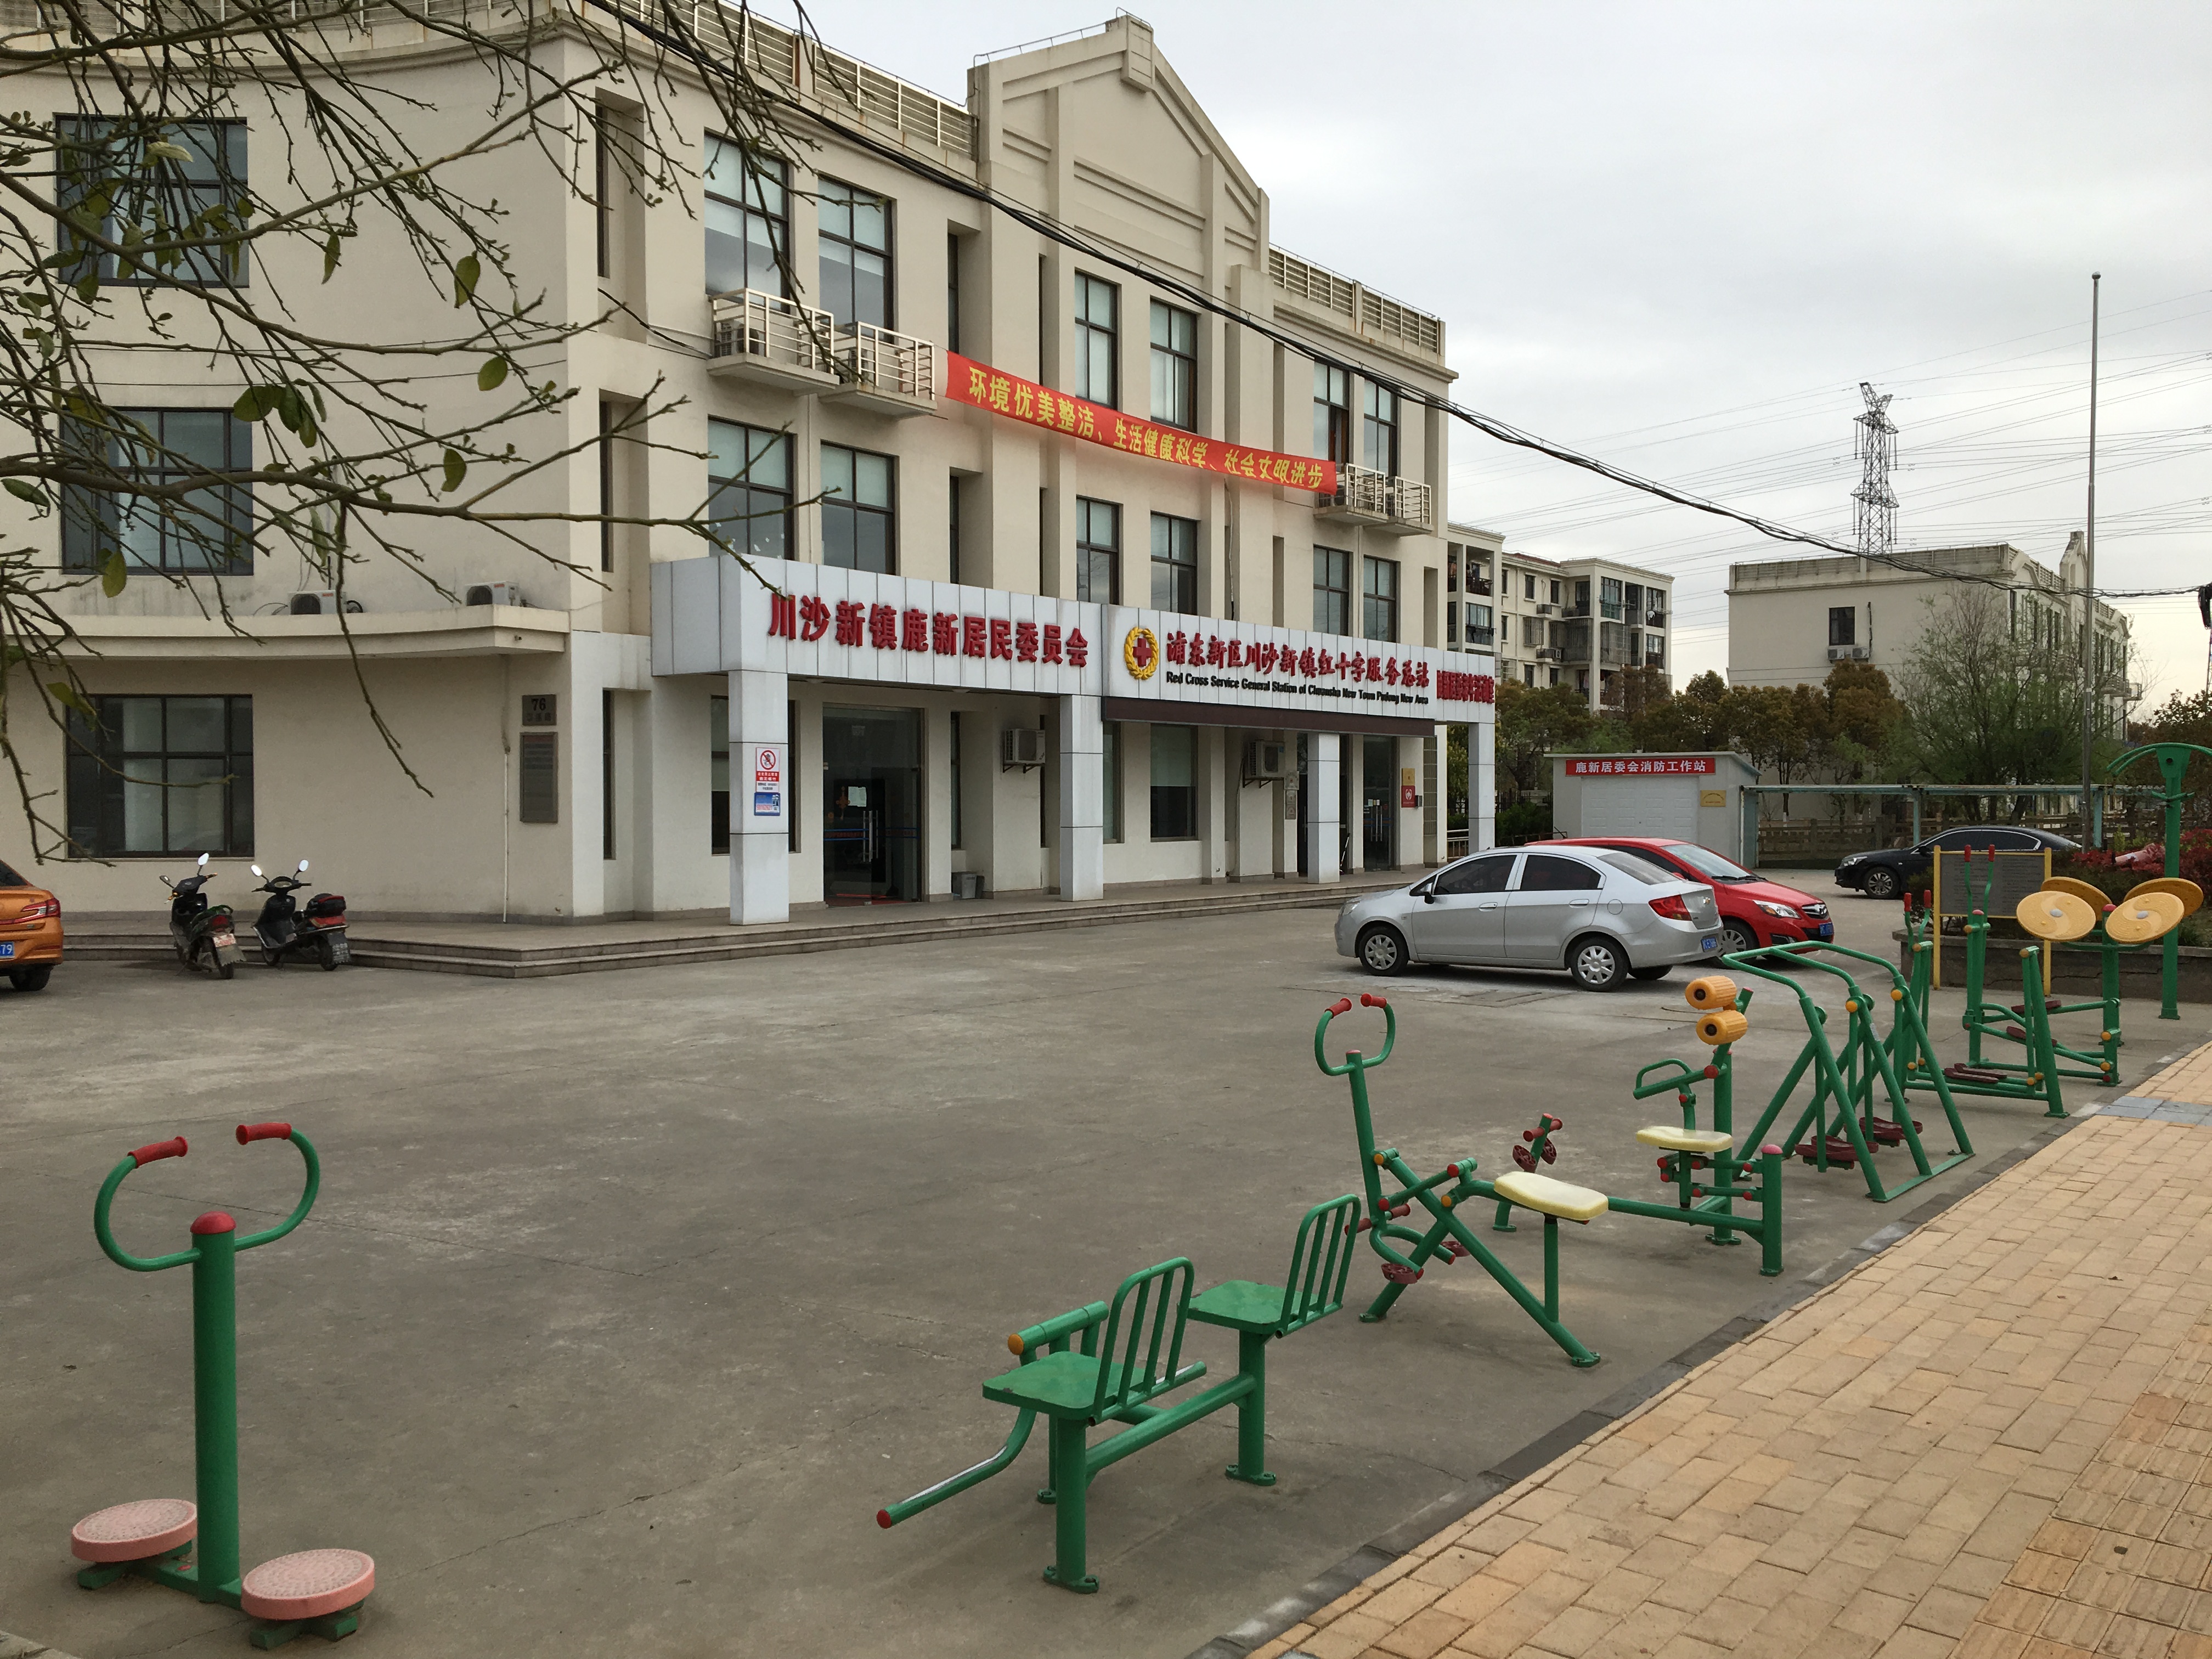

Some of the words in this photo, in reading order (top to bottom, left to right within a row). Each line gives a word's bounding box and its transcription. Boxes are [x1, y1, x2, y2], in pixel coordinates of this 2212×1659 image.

[769, 593, 1088, 668] 川沙新镇鹿新居民委员会
[1166, 631, 1430, 687] 浦东新区川沙新镇红十字服务总站
[1166, 671, 1183, 684] Red
[1186, 673, 1209, 686] Cross
[1211, 675, 1239, 688] Service
[1242, 678, 1270, 691] General
[1272, 681, 1297, 693] Station
[1299, 684, 1307, 694] of
[1342, 687, 1357, 698] New
[1358, 689, 1375, 700] Town
[1400, 693, 1414, 703] New
[531, 698, 546, 711] 76
[1576, 760, 1706, 773] 鹿新居委会消防工作站
[1, 944, 12, 955] 79
